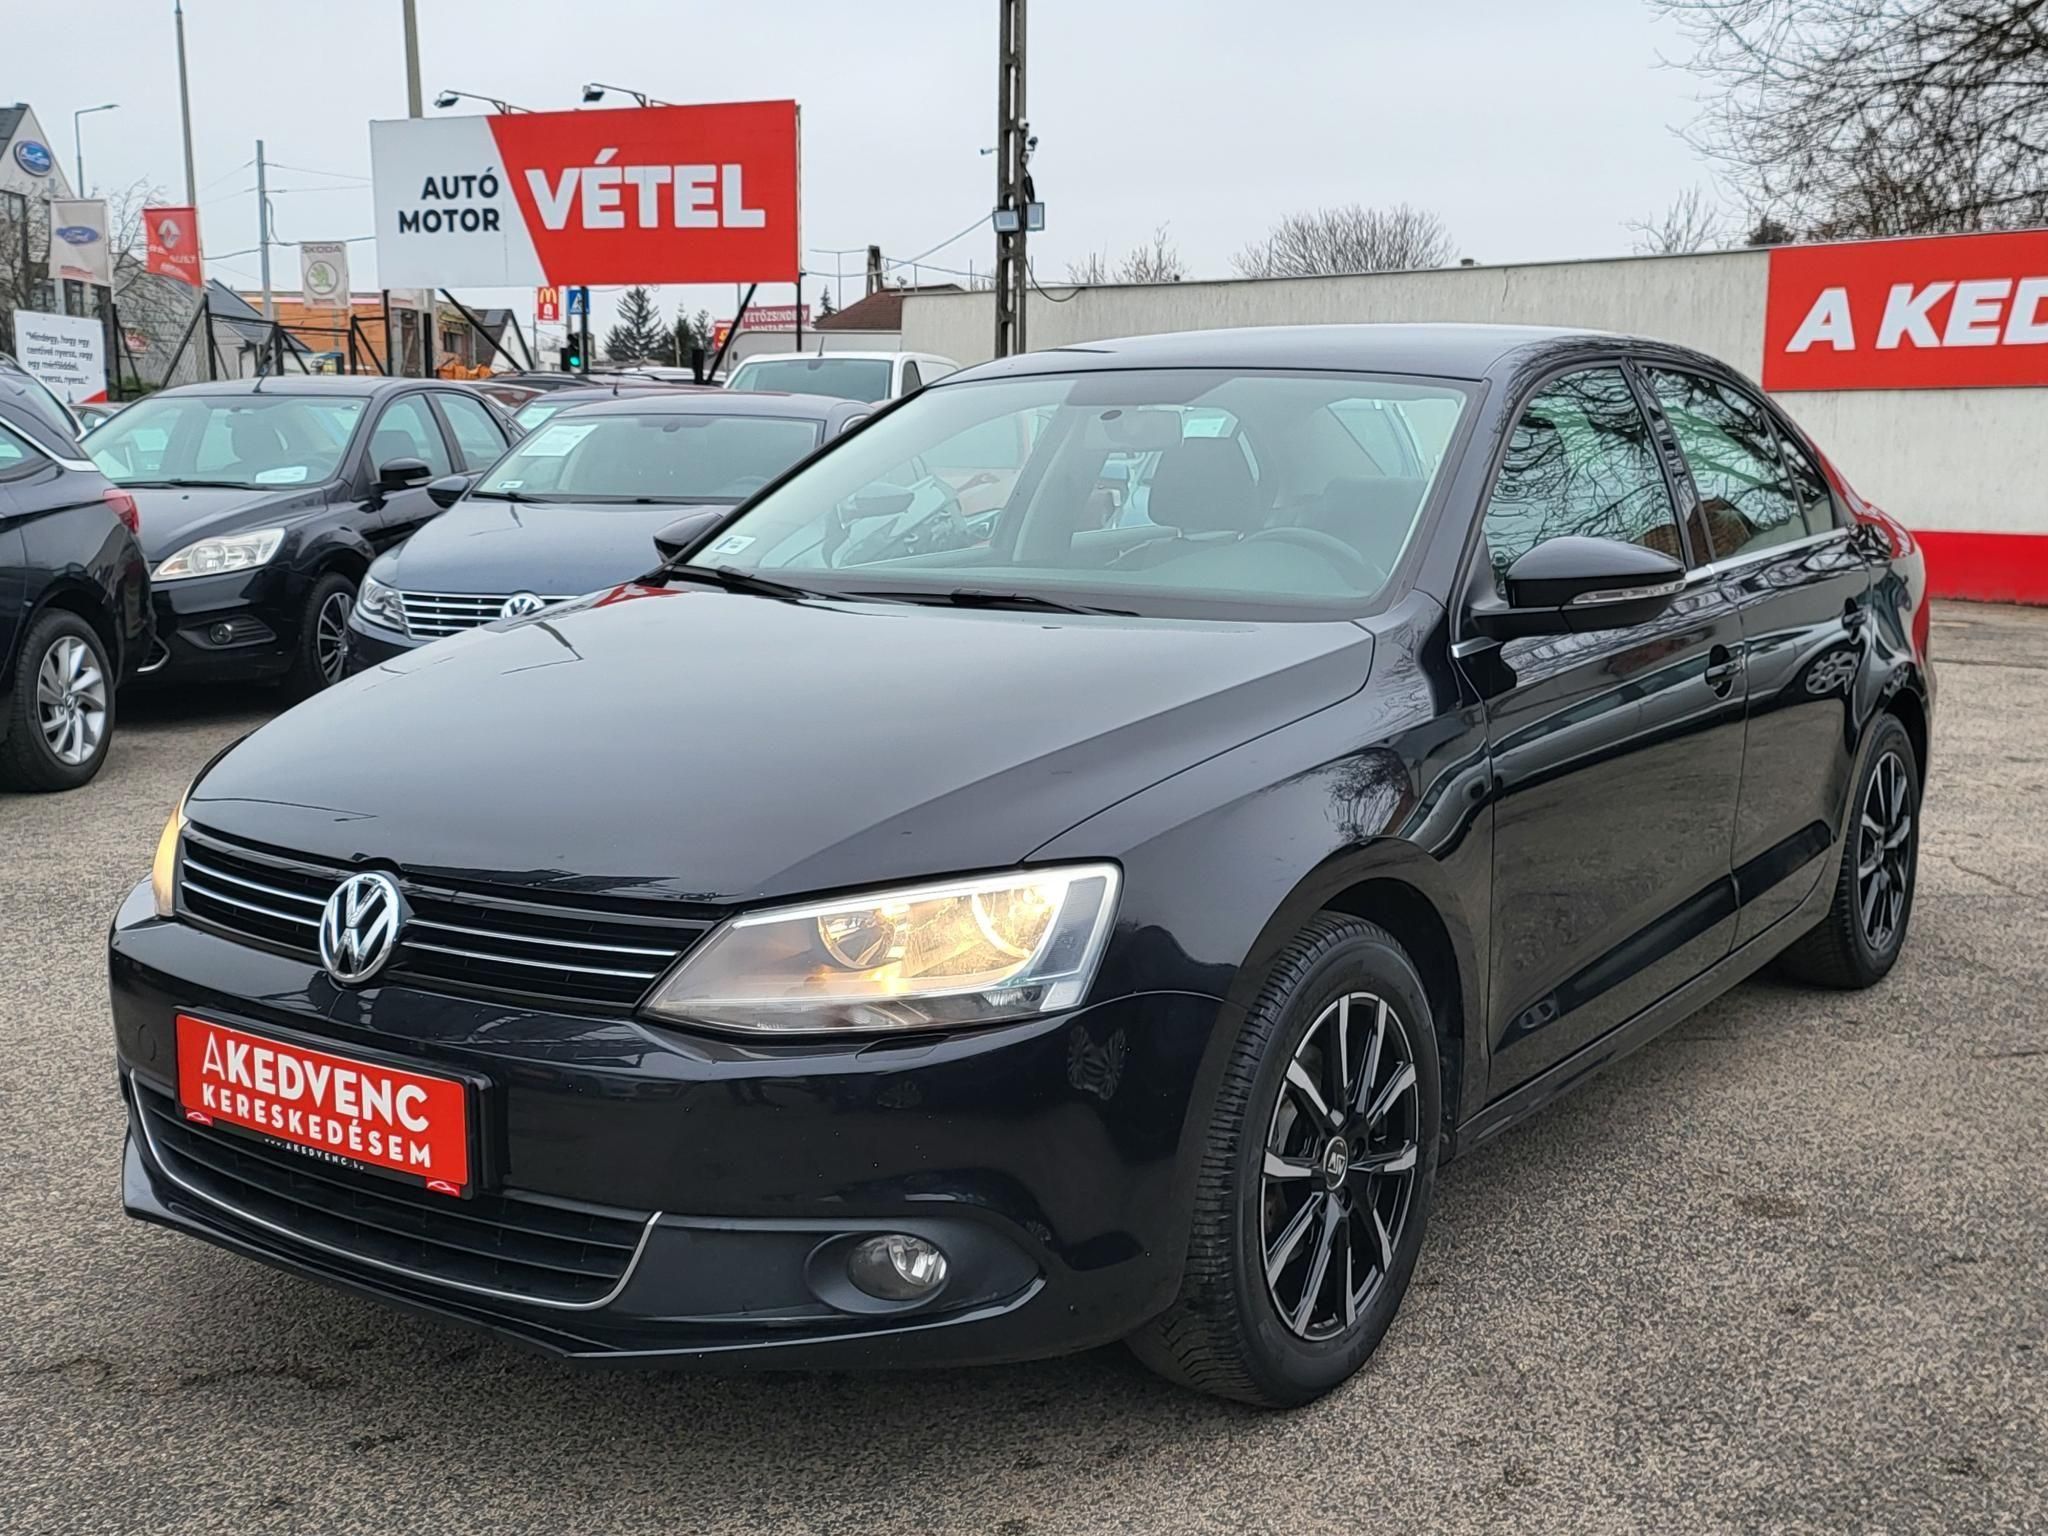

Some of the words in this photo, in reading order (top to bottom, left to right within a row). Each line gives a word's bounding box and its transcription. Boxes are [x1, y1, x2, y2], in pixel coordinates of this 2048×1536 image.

[398, 208, 500, 234] MOTOR
[421, 166, 499, 201] AUTÓ
[524, 147, 767, 231] VÉTEL
[1784, 286, 1856, 353] A
[1875, 276, 2048, 350] KED
[202, 1083, 432, 1169] KERESKEDÉSEM
